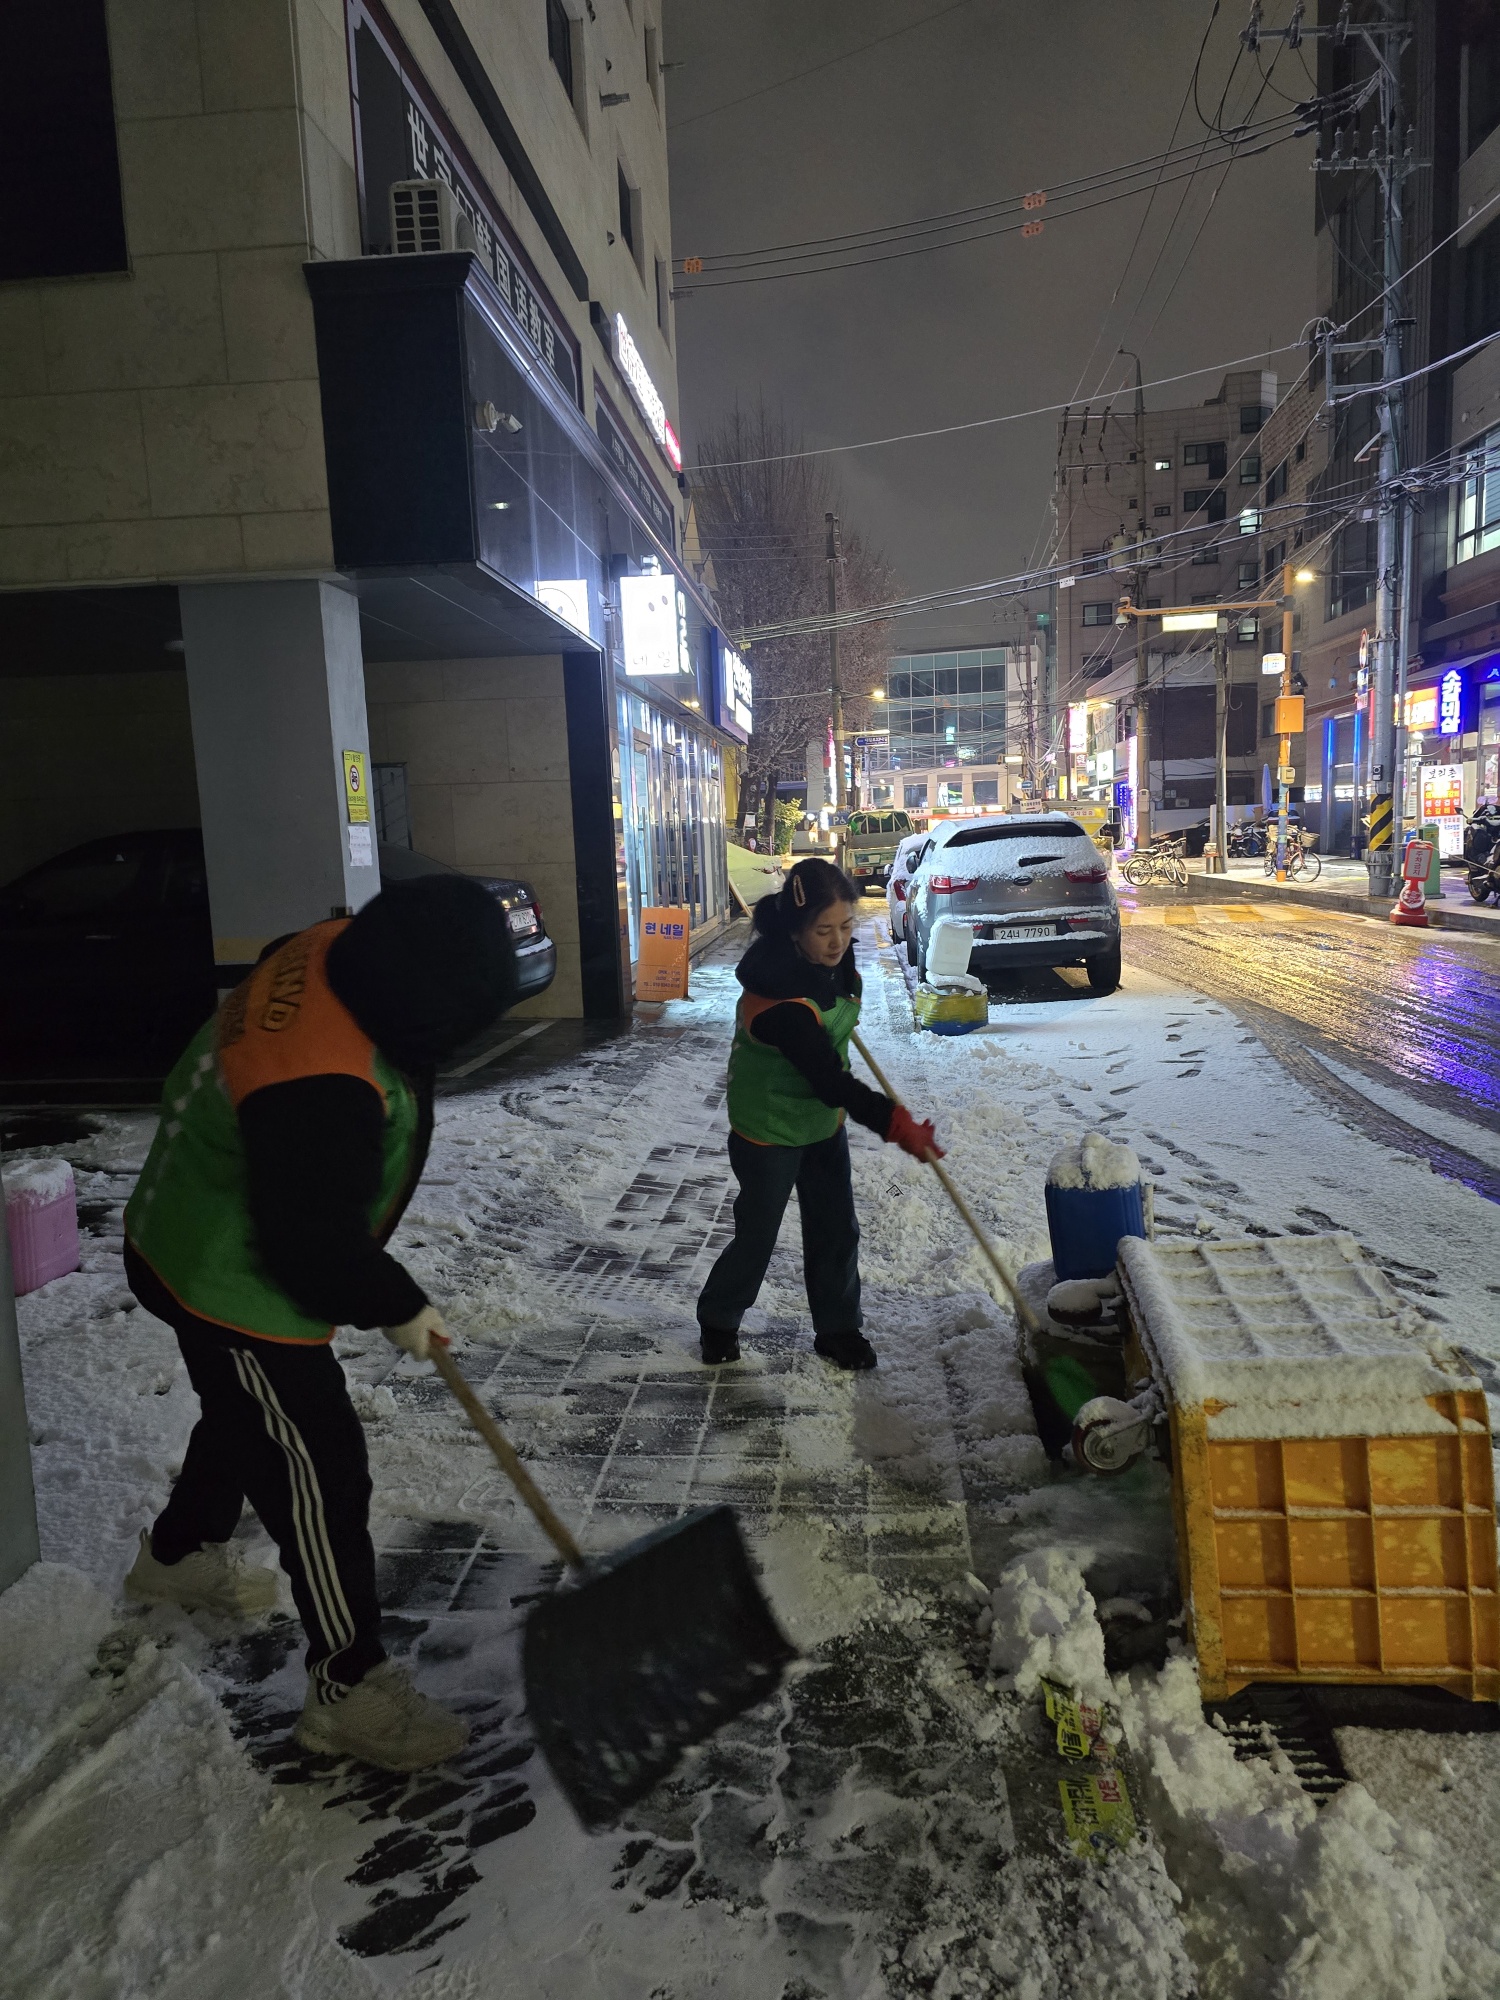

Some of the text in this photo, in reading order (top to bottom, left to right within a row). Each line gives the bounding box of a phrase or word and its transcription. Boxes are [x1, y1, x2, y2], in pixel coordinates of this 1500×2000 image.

[645, 922, 684, 936] 현 네일
[1024, 927, 1050, 938] 7790
